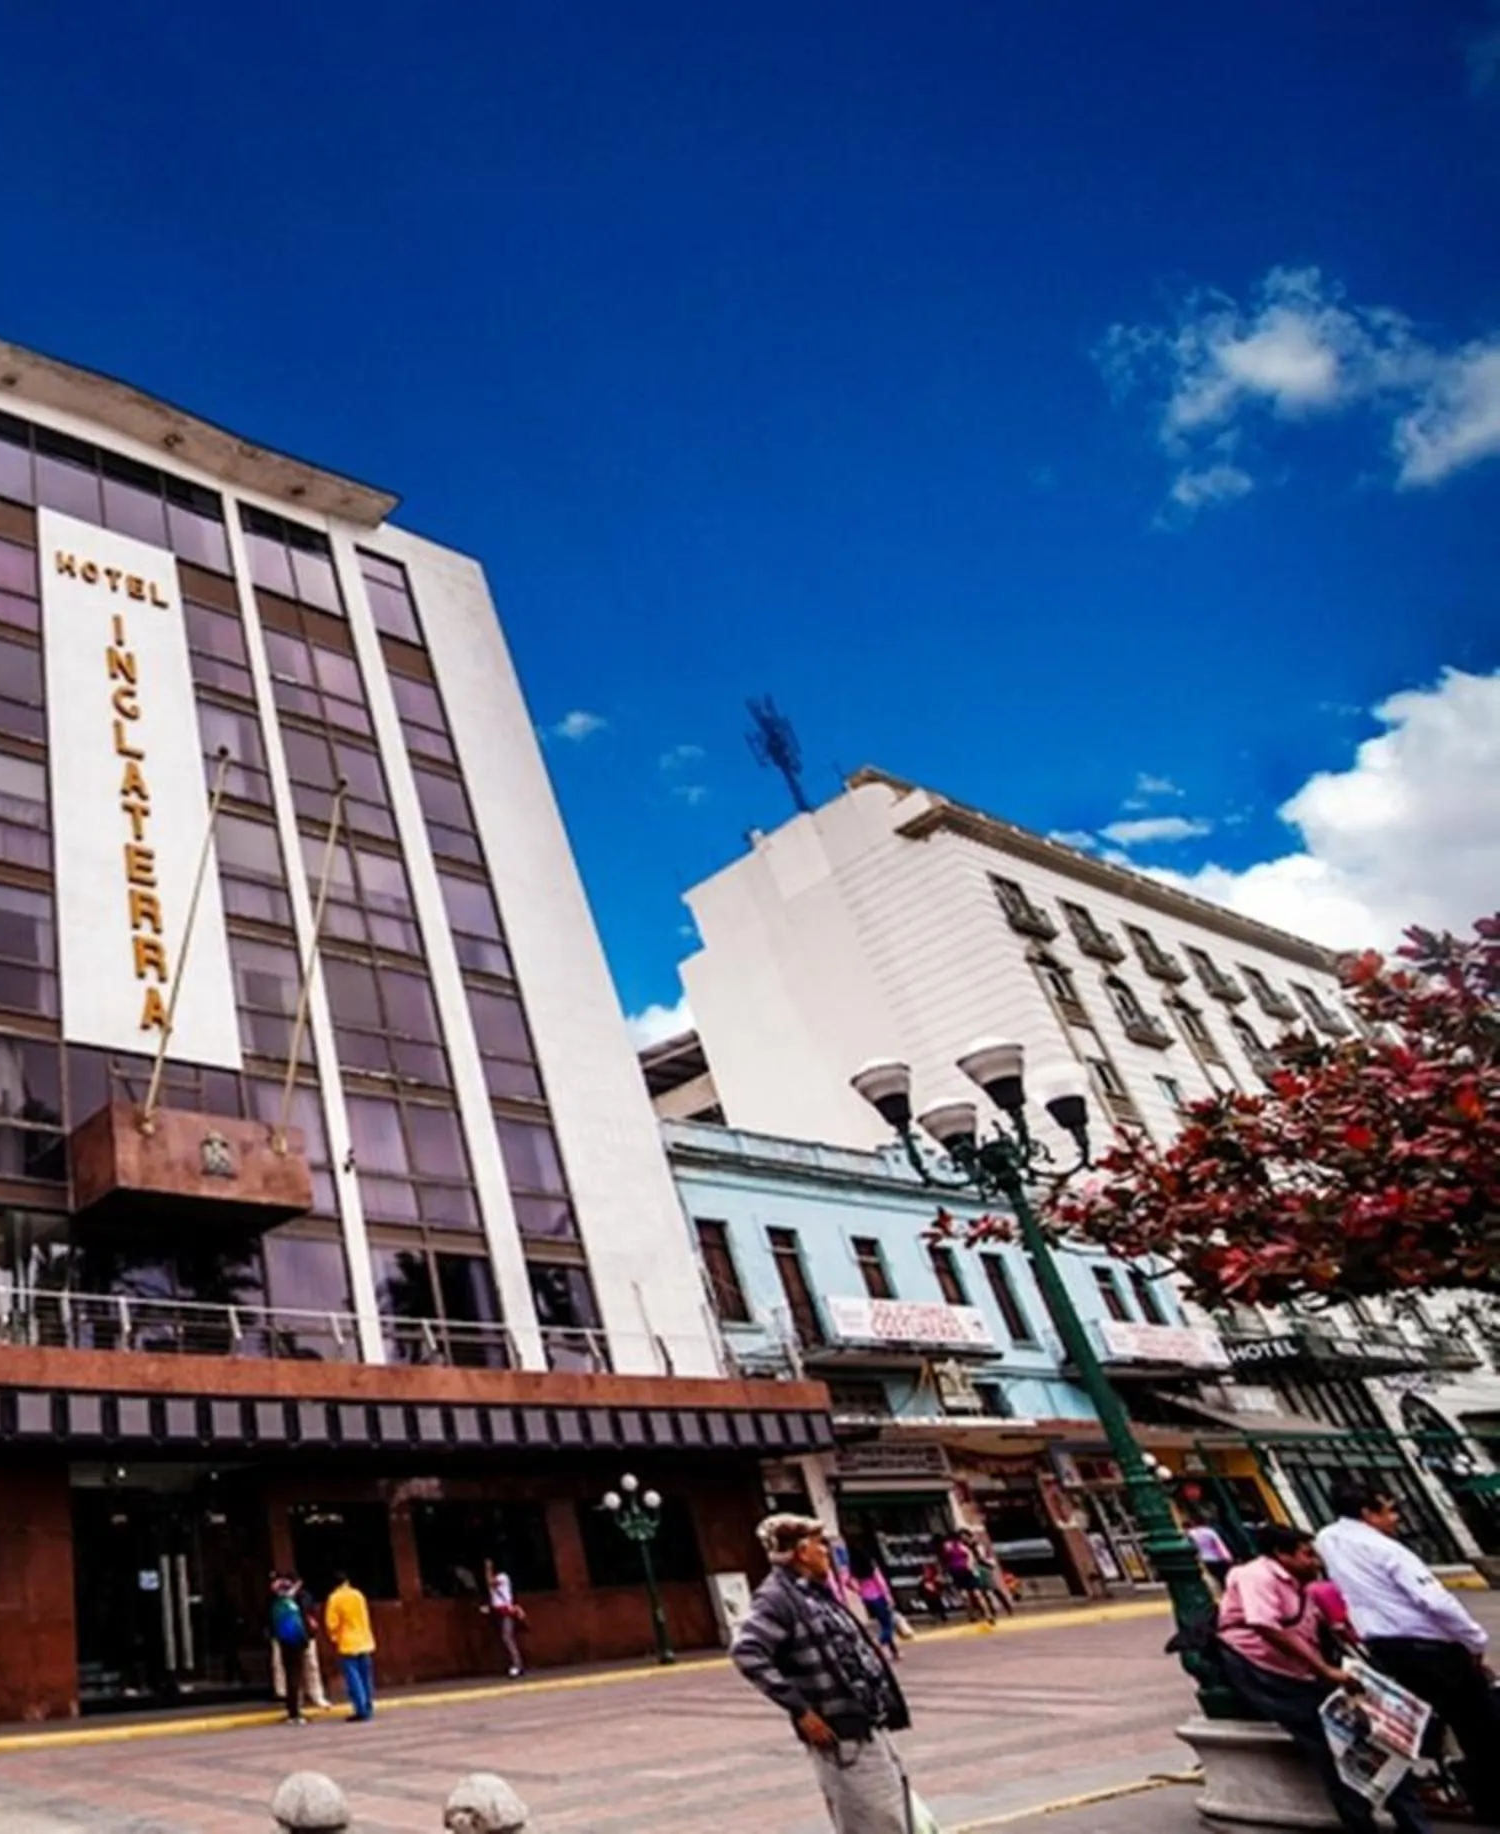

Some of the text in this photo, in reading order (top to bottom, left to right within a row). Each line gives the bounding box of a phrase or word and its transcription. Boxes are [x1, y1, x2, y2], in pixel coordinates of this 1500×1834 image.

[55, 550, 169, 611] HOTEL
[106, 614, 170, 1031] INGLATERRA
[1229, 1339, 1300, 1362] HOTEL
